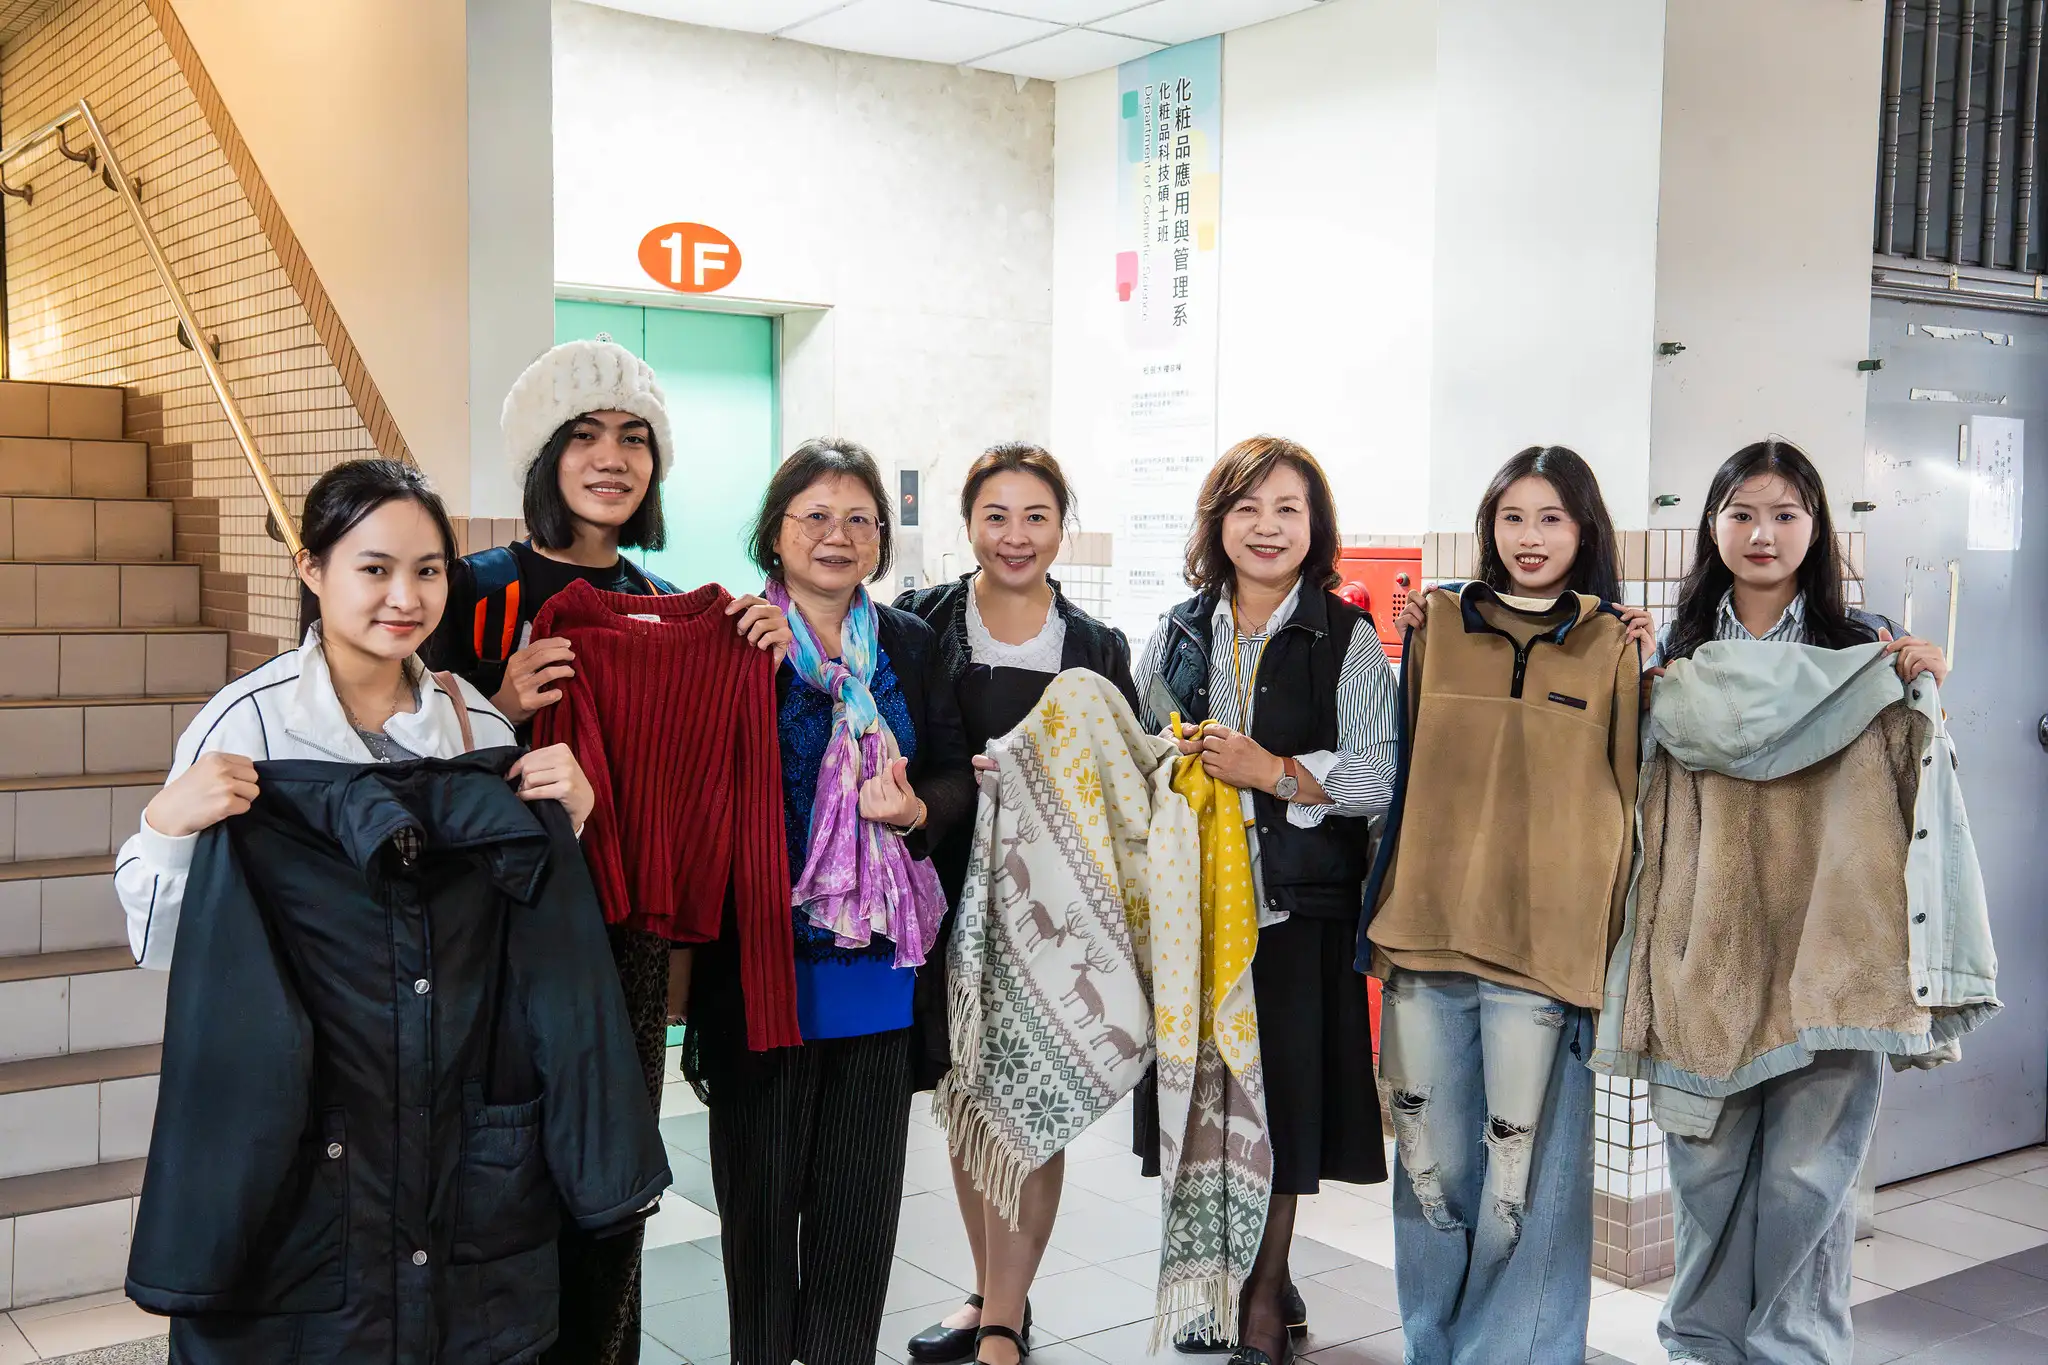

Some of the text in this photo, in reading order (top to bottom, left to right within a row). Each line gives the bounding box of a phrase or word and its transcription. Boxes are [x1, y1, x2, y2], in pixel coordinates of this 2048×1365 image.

[1143, 85, 1153, 168] Department
[1157, 82, 1171, 242] 化粧品科技碩士班
[660, 232, 730, 286] 1F
[1173, 78, 1192, 326] 化粧品應用與管理系
